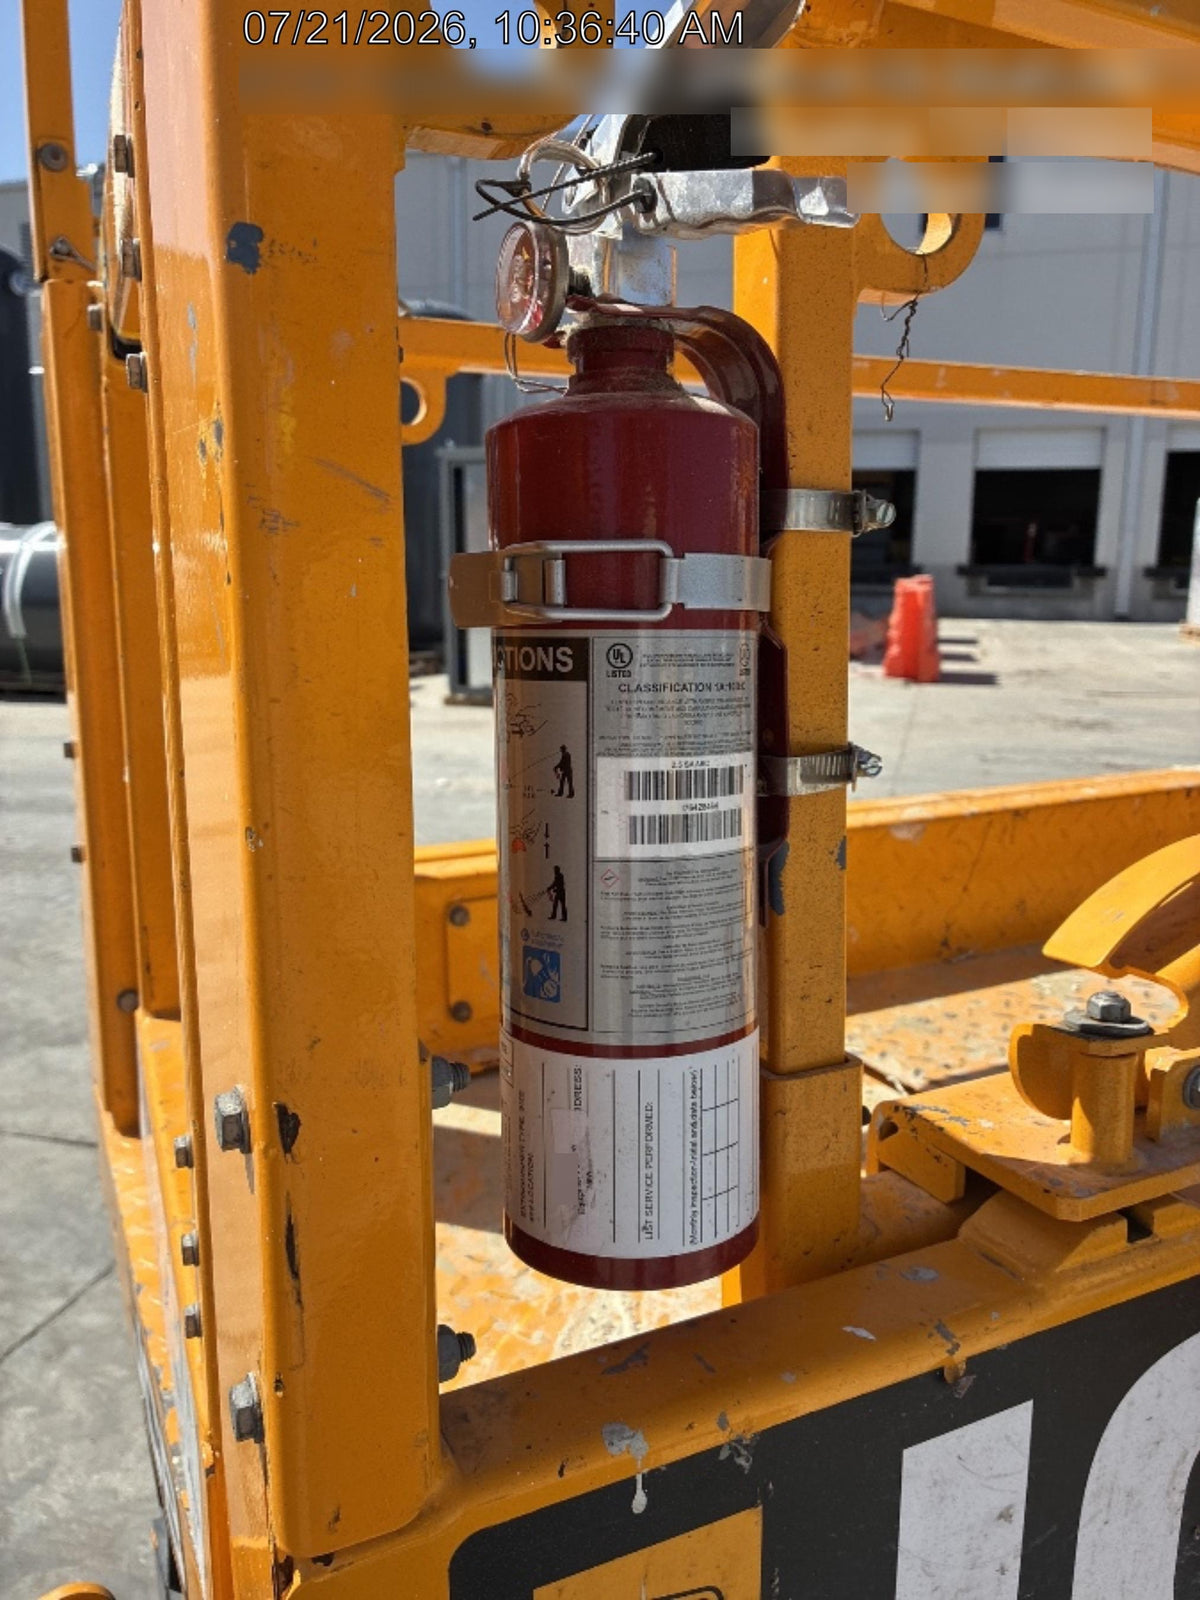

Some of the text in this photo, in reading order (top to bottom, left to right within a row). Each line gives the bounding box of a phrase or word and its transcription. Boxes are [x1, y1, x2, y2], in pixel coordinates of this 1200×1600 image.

[607, 669, 632, 678] LISTED
[618, 682, 712, 693] CLASSIFICATION
[644, 1102, 653, 1240] LIST SERVICE PERFORMED:
